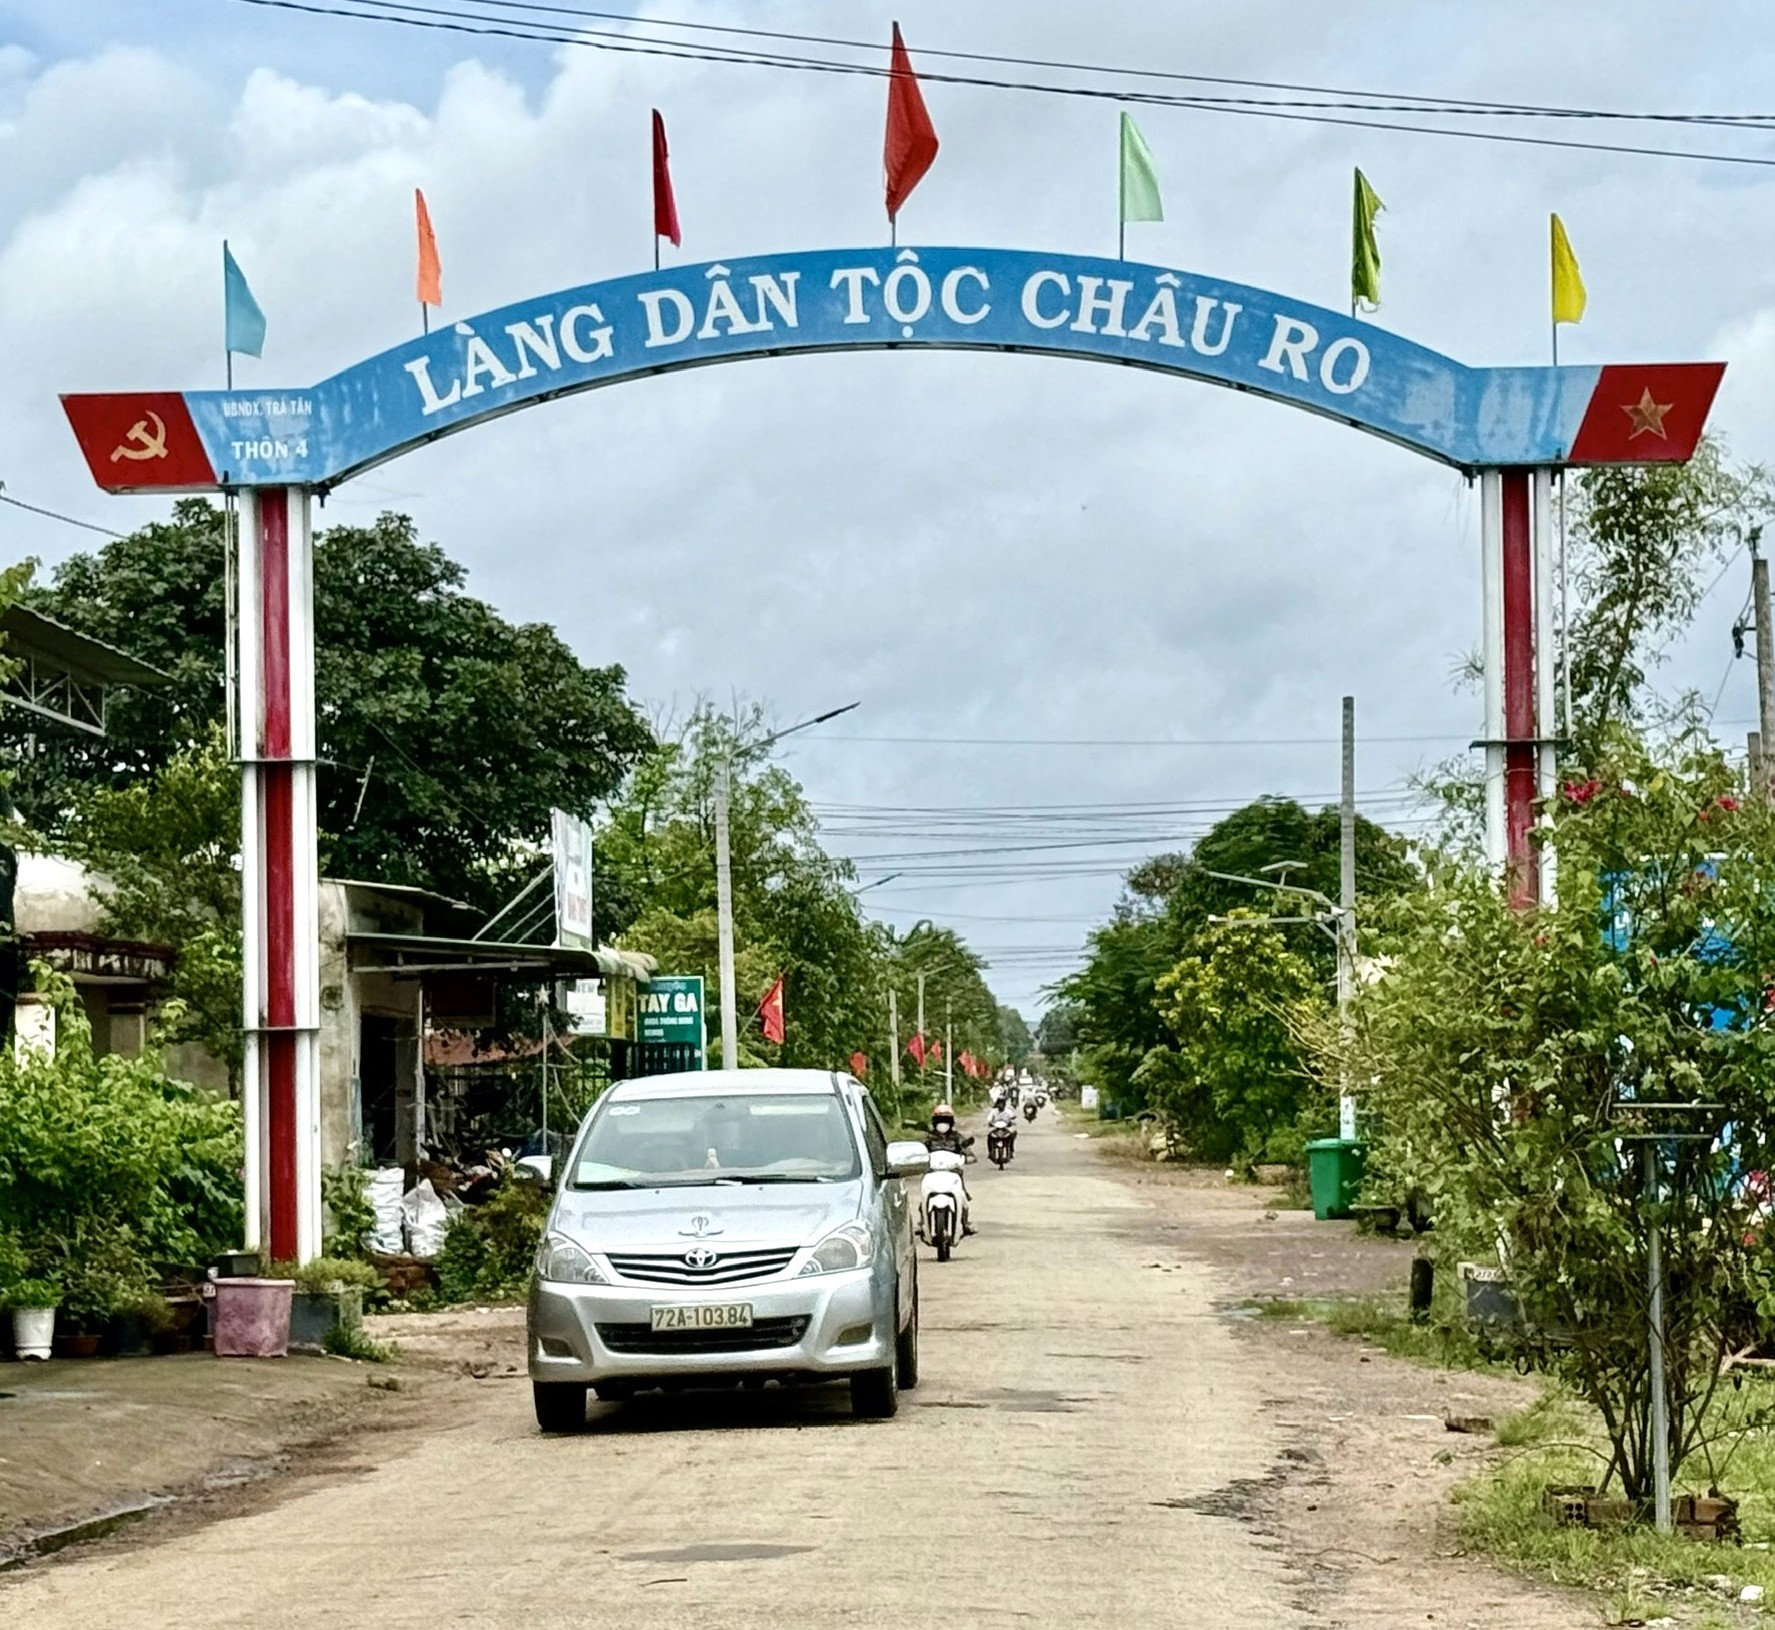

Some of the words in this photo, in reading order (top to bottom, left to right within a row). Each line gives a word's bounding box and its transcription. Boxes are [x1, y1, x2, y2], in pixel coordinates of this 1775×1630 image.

[404, 303, 614, 416] LÀNG
[637, 263, 801, 348] DÂN
[829, 249, 991, 338] TỘC
[1020, 270, 1243, 356] CHÂU
[1258, 313, 1371, 394] RO
[231, 435, 288, 459] THÔN
[296, 439, 309, 458] 4
[638, 993, 670, 1013] TAY
[674, 992, 699, 1013] GA
